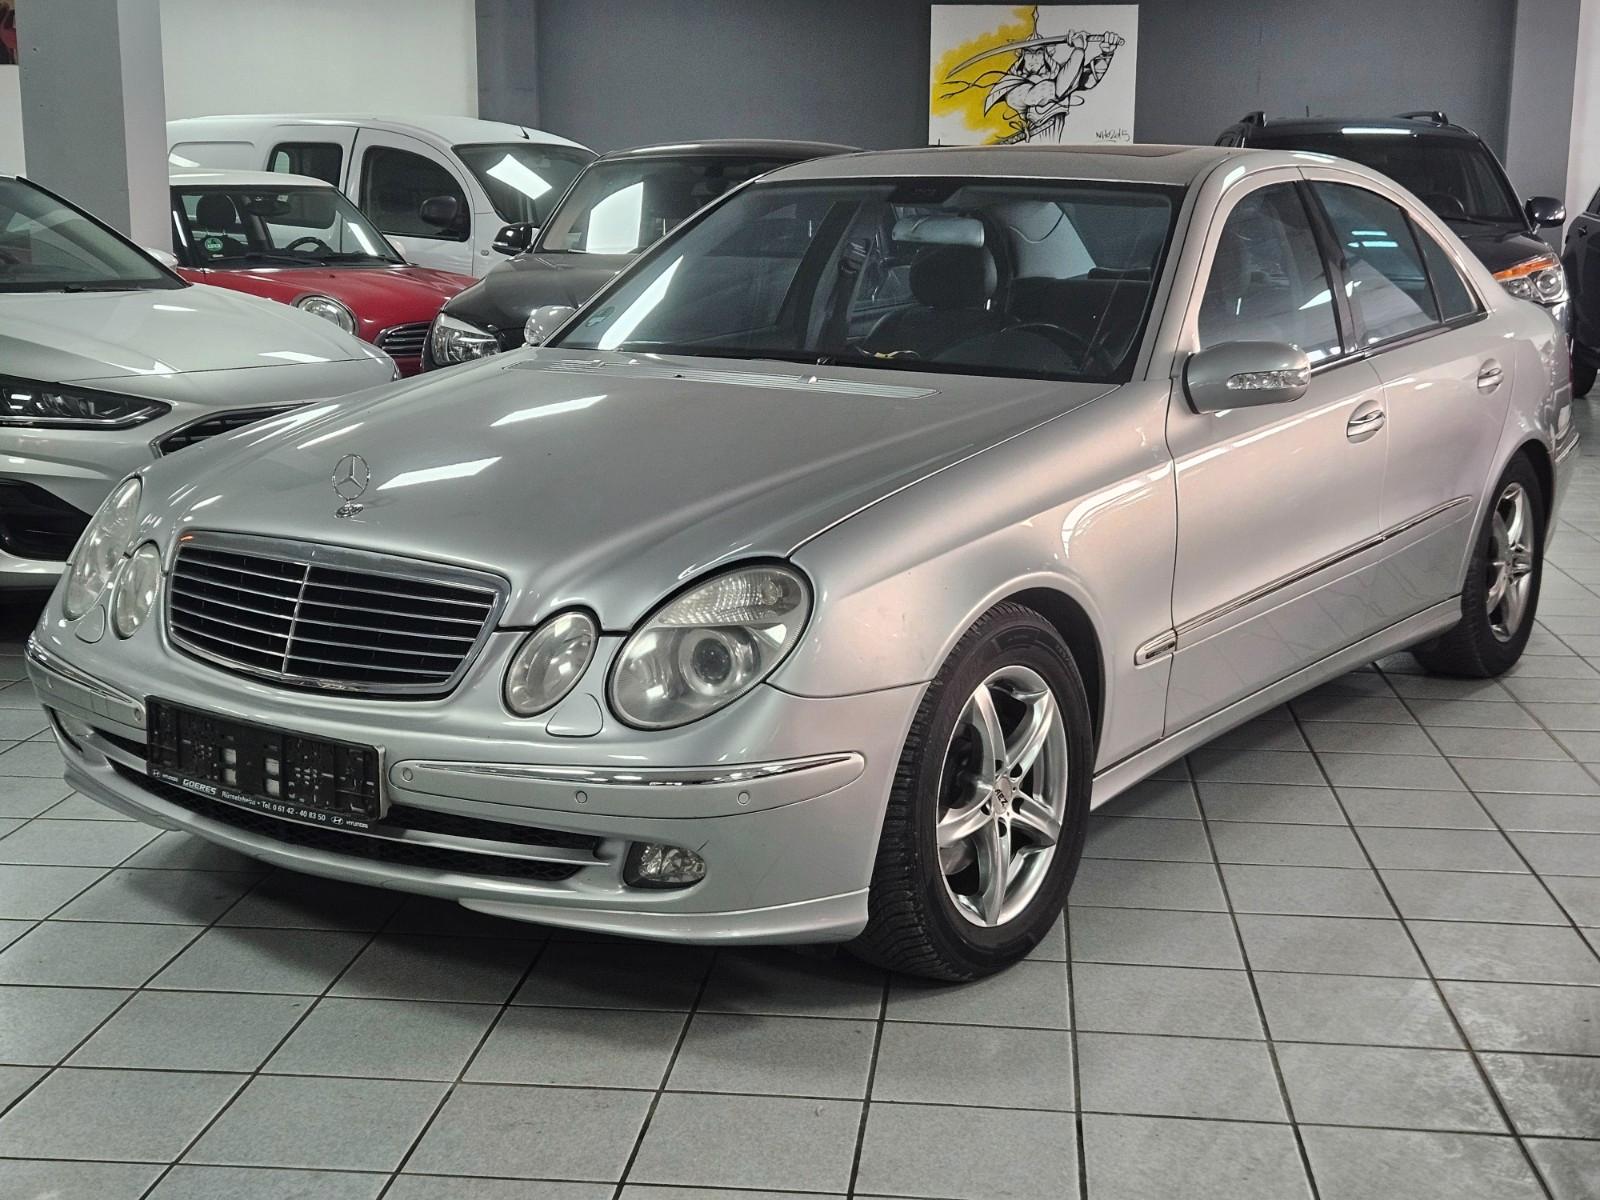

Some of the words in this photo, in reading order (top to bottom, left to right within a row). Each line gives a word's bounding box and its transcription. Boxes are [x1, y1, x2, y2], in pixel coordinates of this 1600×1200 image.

[182, 778, 217, 795] GOERES
[262, 801, 271, 810] Tel.
[277, 805, 285, 813] 61
[286, 807, 295, 815] 42
[299, 810, 307, 818] 40
[317, 813, 326, 821] 50
[995, 789, 1008, 807] AEZ
